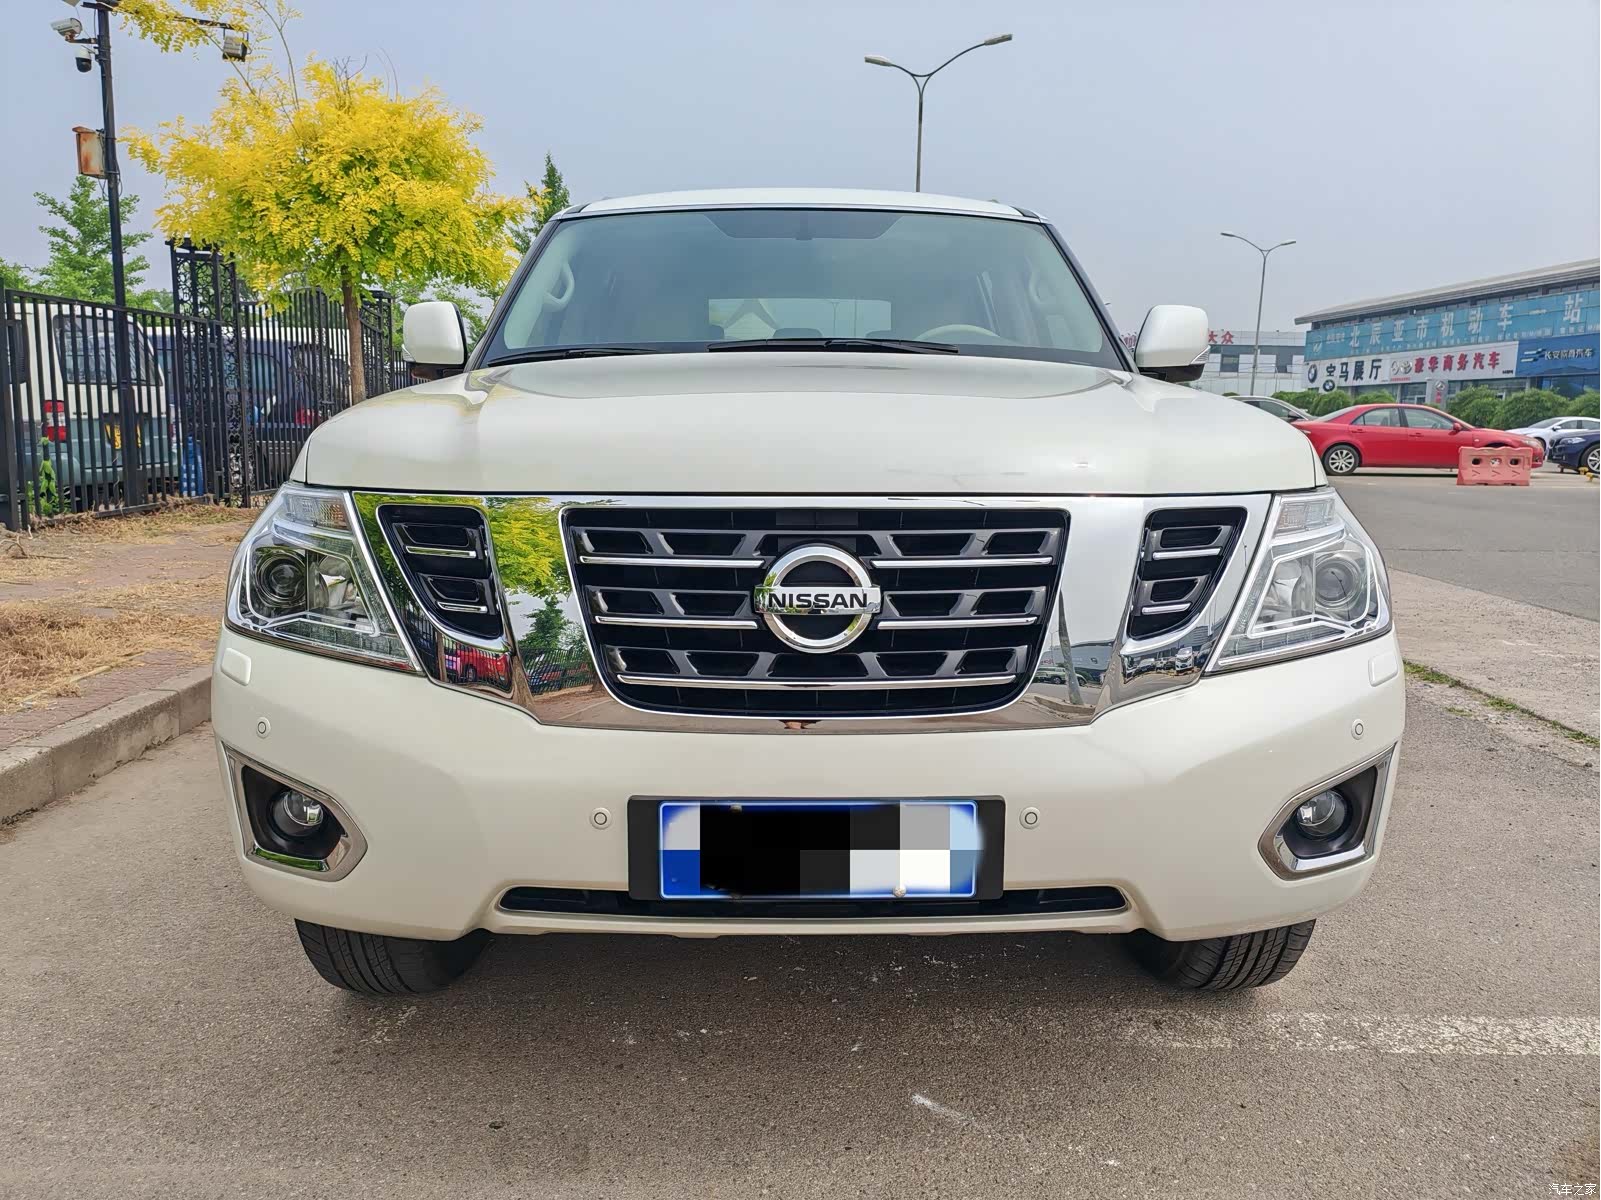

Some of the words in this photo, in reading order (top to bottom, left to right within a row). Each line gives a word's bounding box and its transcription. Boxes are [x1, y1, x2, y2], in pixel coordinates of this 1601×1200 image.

[1208, 331, 1234, 344] 大众
[1414, 351, 1500, 374] 豪华商务汽车
[768, 593, 868, 609] NISSAN
